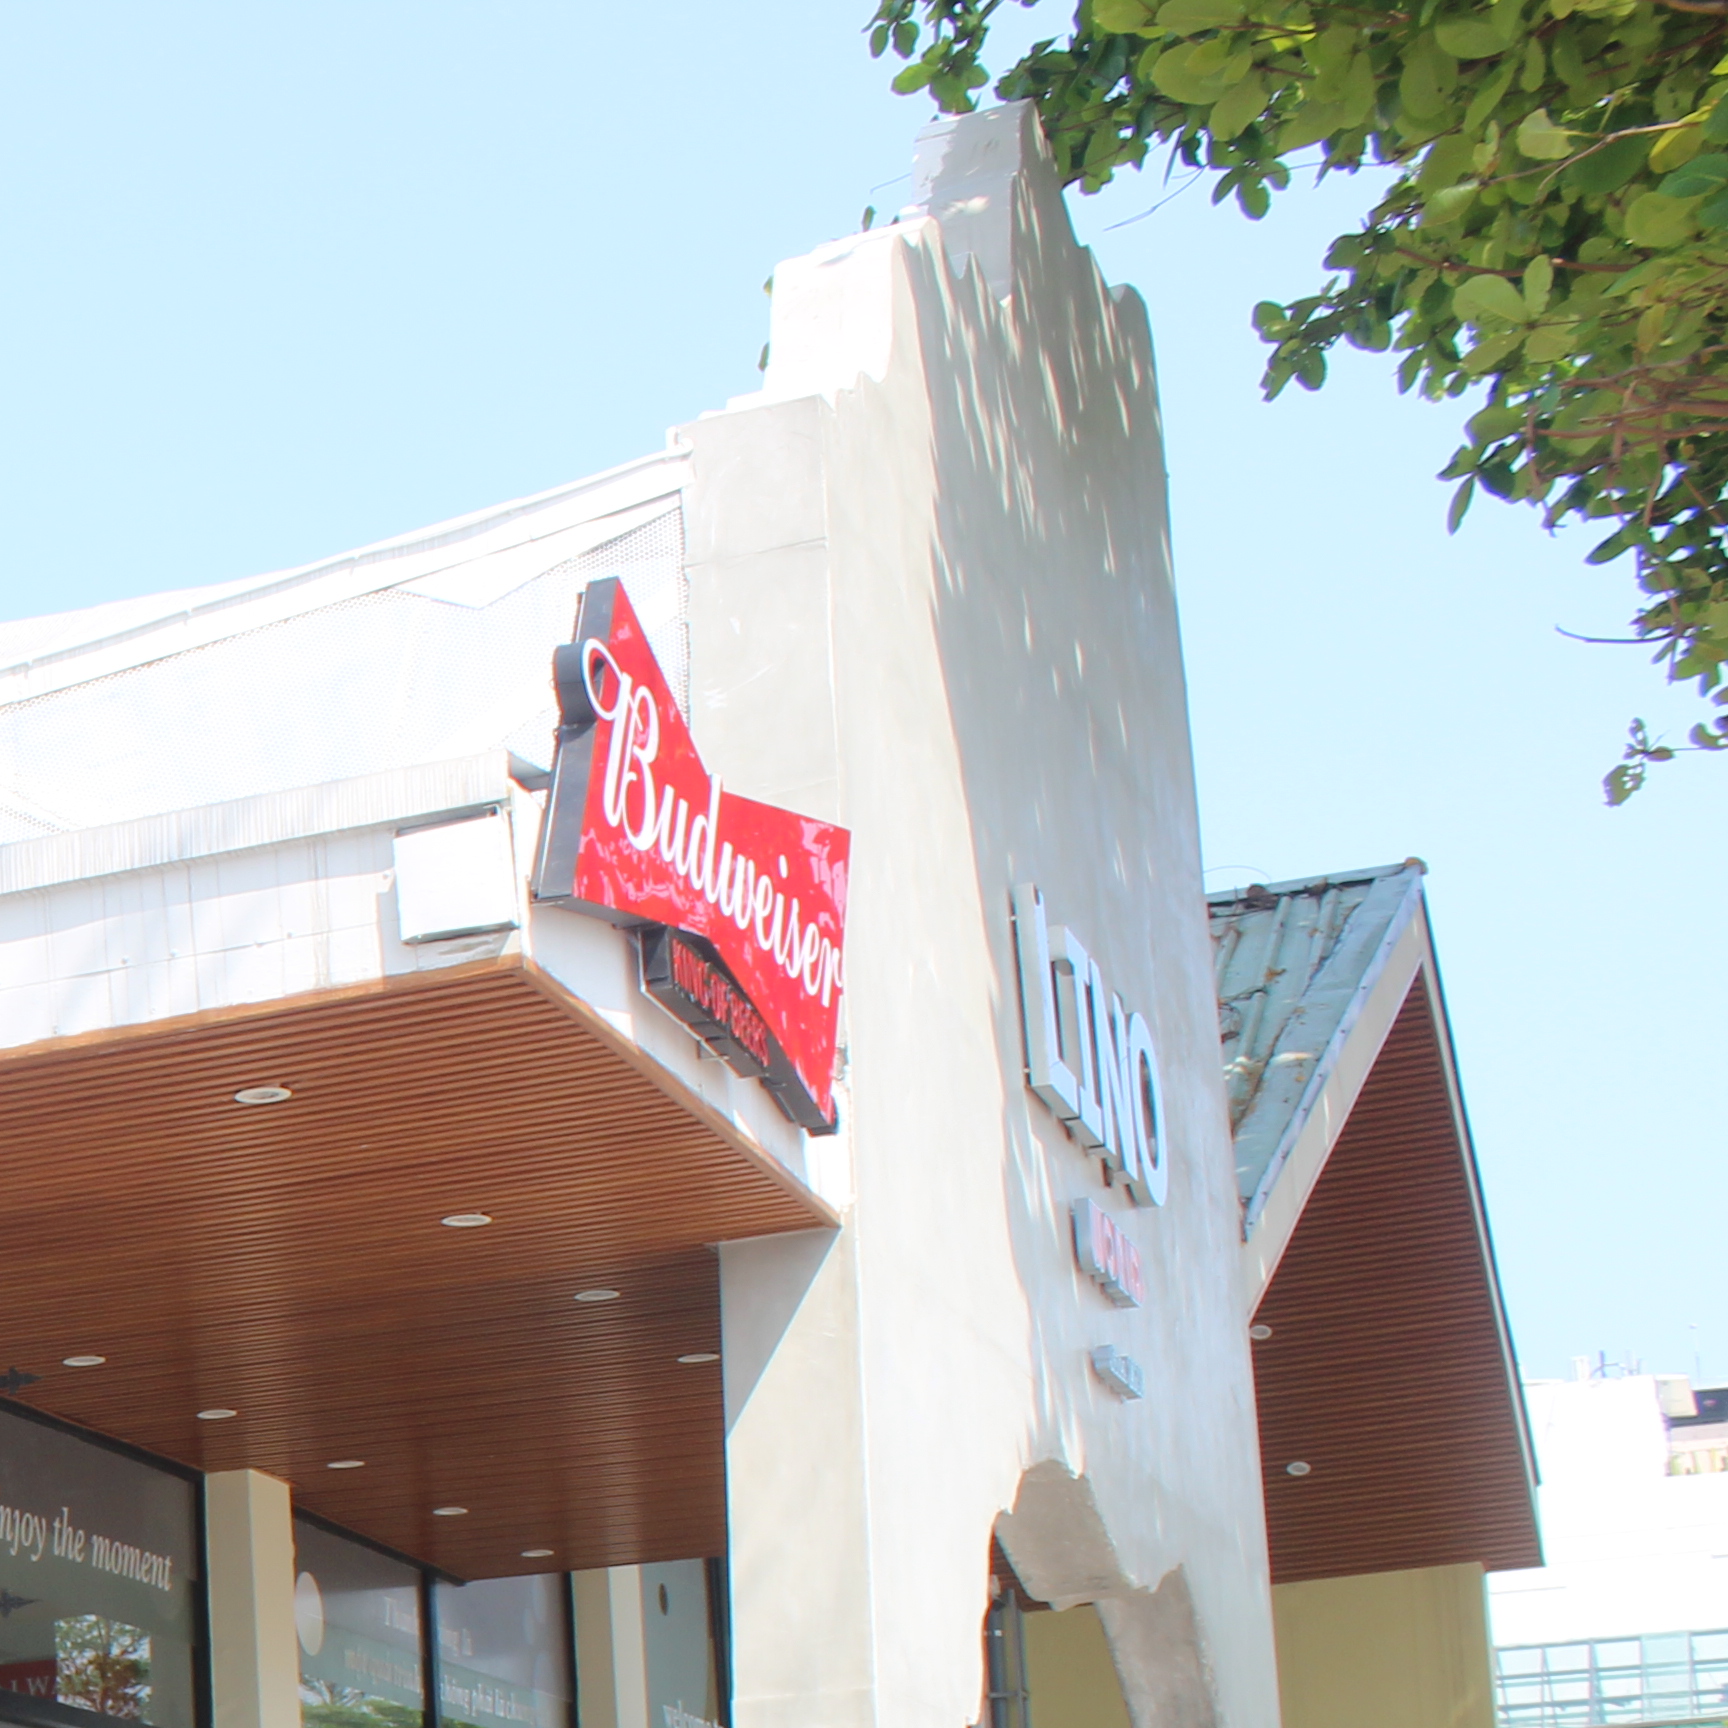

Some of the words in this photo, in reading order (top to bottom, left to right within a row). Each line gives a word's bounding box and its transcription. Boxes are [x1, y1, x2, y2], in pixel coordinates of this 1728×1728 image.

[580, 637, 844, 1008] Budweiser
[1020, 883, 1169, 1207] LINO
[52, 1505, 85, 1563] the
[90, 1533, 173, 1592] moment
